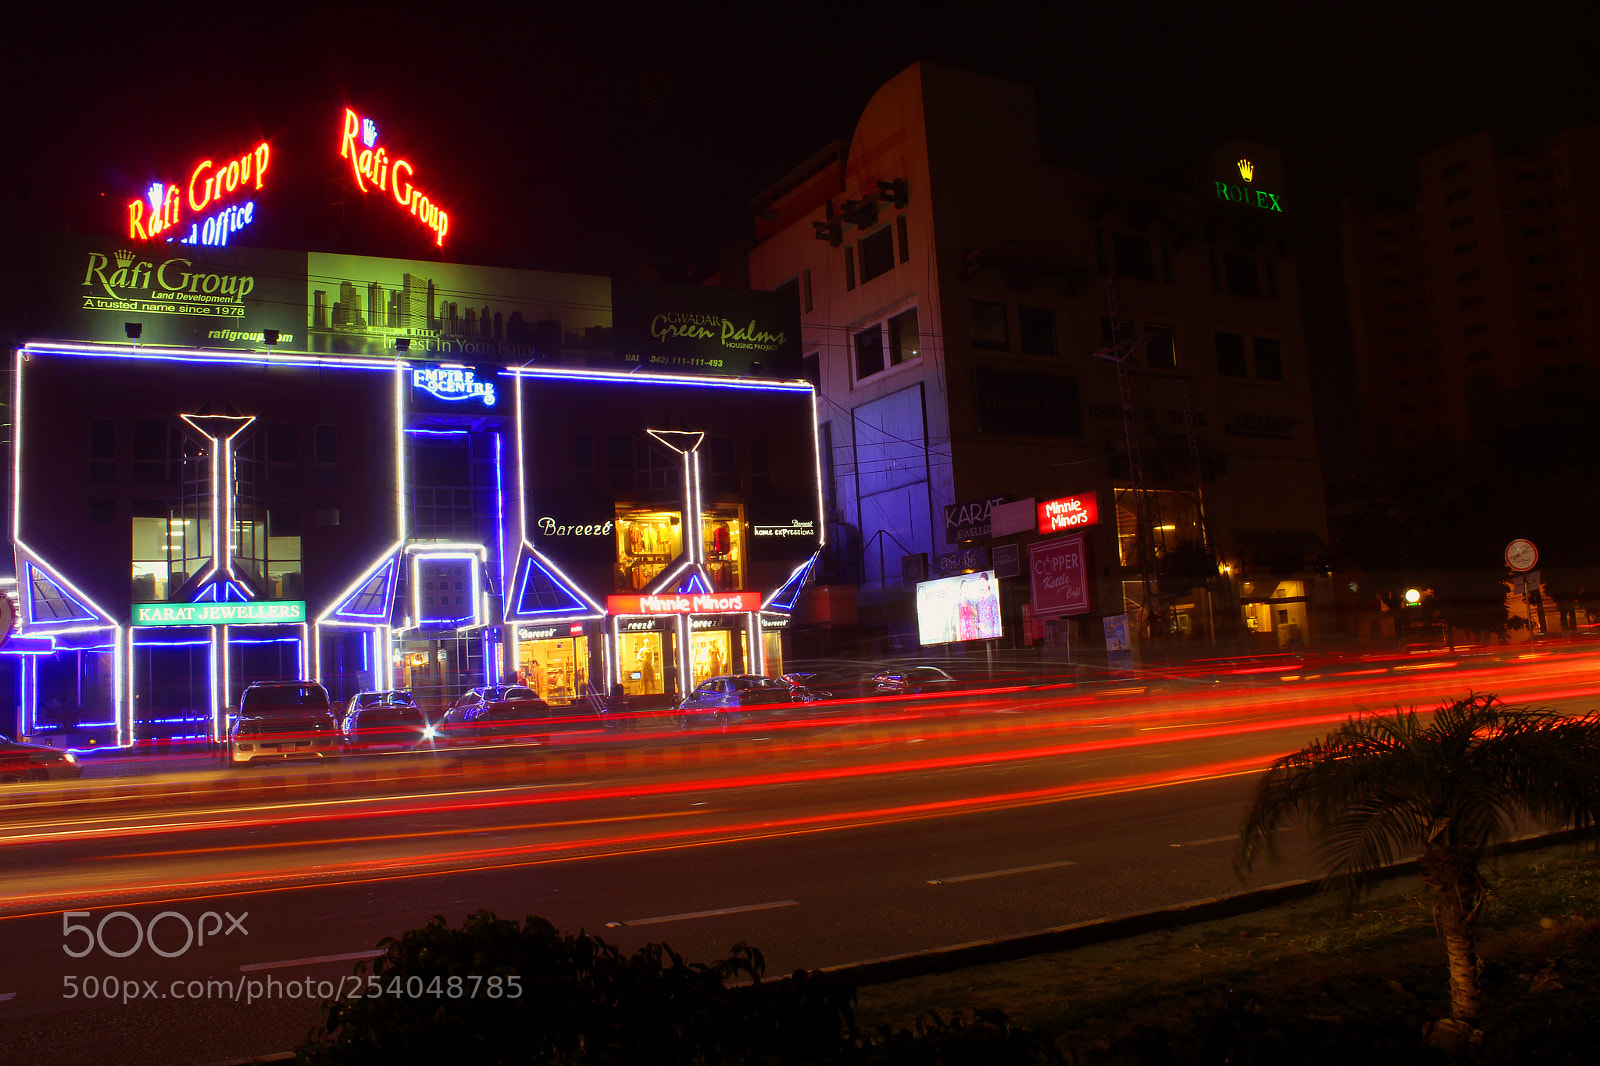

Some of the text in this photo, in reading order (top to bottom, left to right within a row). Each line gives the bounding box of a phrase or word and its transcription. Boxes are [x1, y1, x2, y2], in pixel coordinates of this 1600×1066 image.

[341, 108, 449, 247] Rafi Group
[128, 142, 269, 240] Rafi Group
[1214, 181, 1283, 212] ROLEX
[202, 201, 254, 246] Office
[82, 252, 255, 304] Rafi Group
[151, 290, 175, 300] Land
[83, 298, 245, 316] A trusted name since 1978
[666, 312, 721, 327] GWADAR
[651, 314, 787, 345] Green Palms
[382, 334, 431, 351] Inest
[437, 337, 452, 352] In
[457, 338, 493, 354] Your
[726, 342, 754, 350] HOUSING
[672, 357, 724, 367] 111-111-493
[413, 369, 475, 387] EMPIRE
[437, 381, 494, 395] CENTRE
[1045, 498, 1082, 518] Minnie
[754, 527, 815, 538] home expressions
[1034, 553, 1079, 576] COPPER
[1042, 572, 1070, 591] Kettle
[138, 605, 300, 621] KARAT JEWELLERS
[640, 595, 691, 613] Minnie
